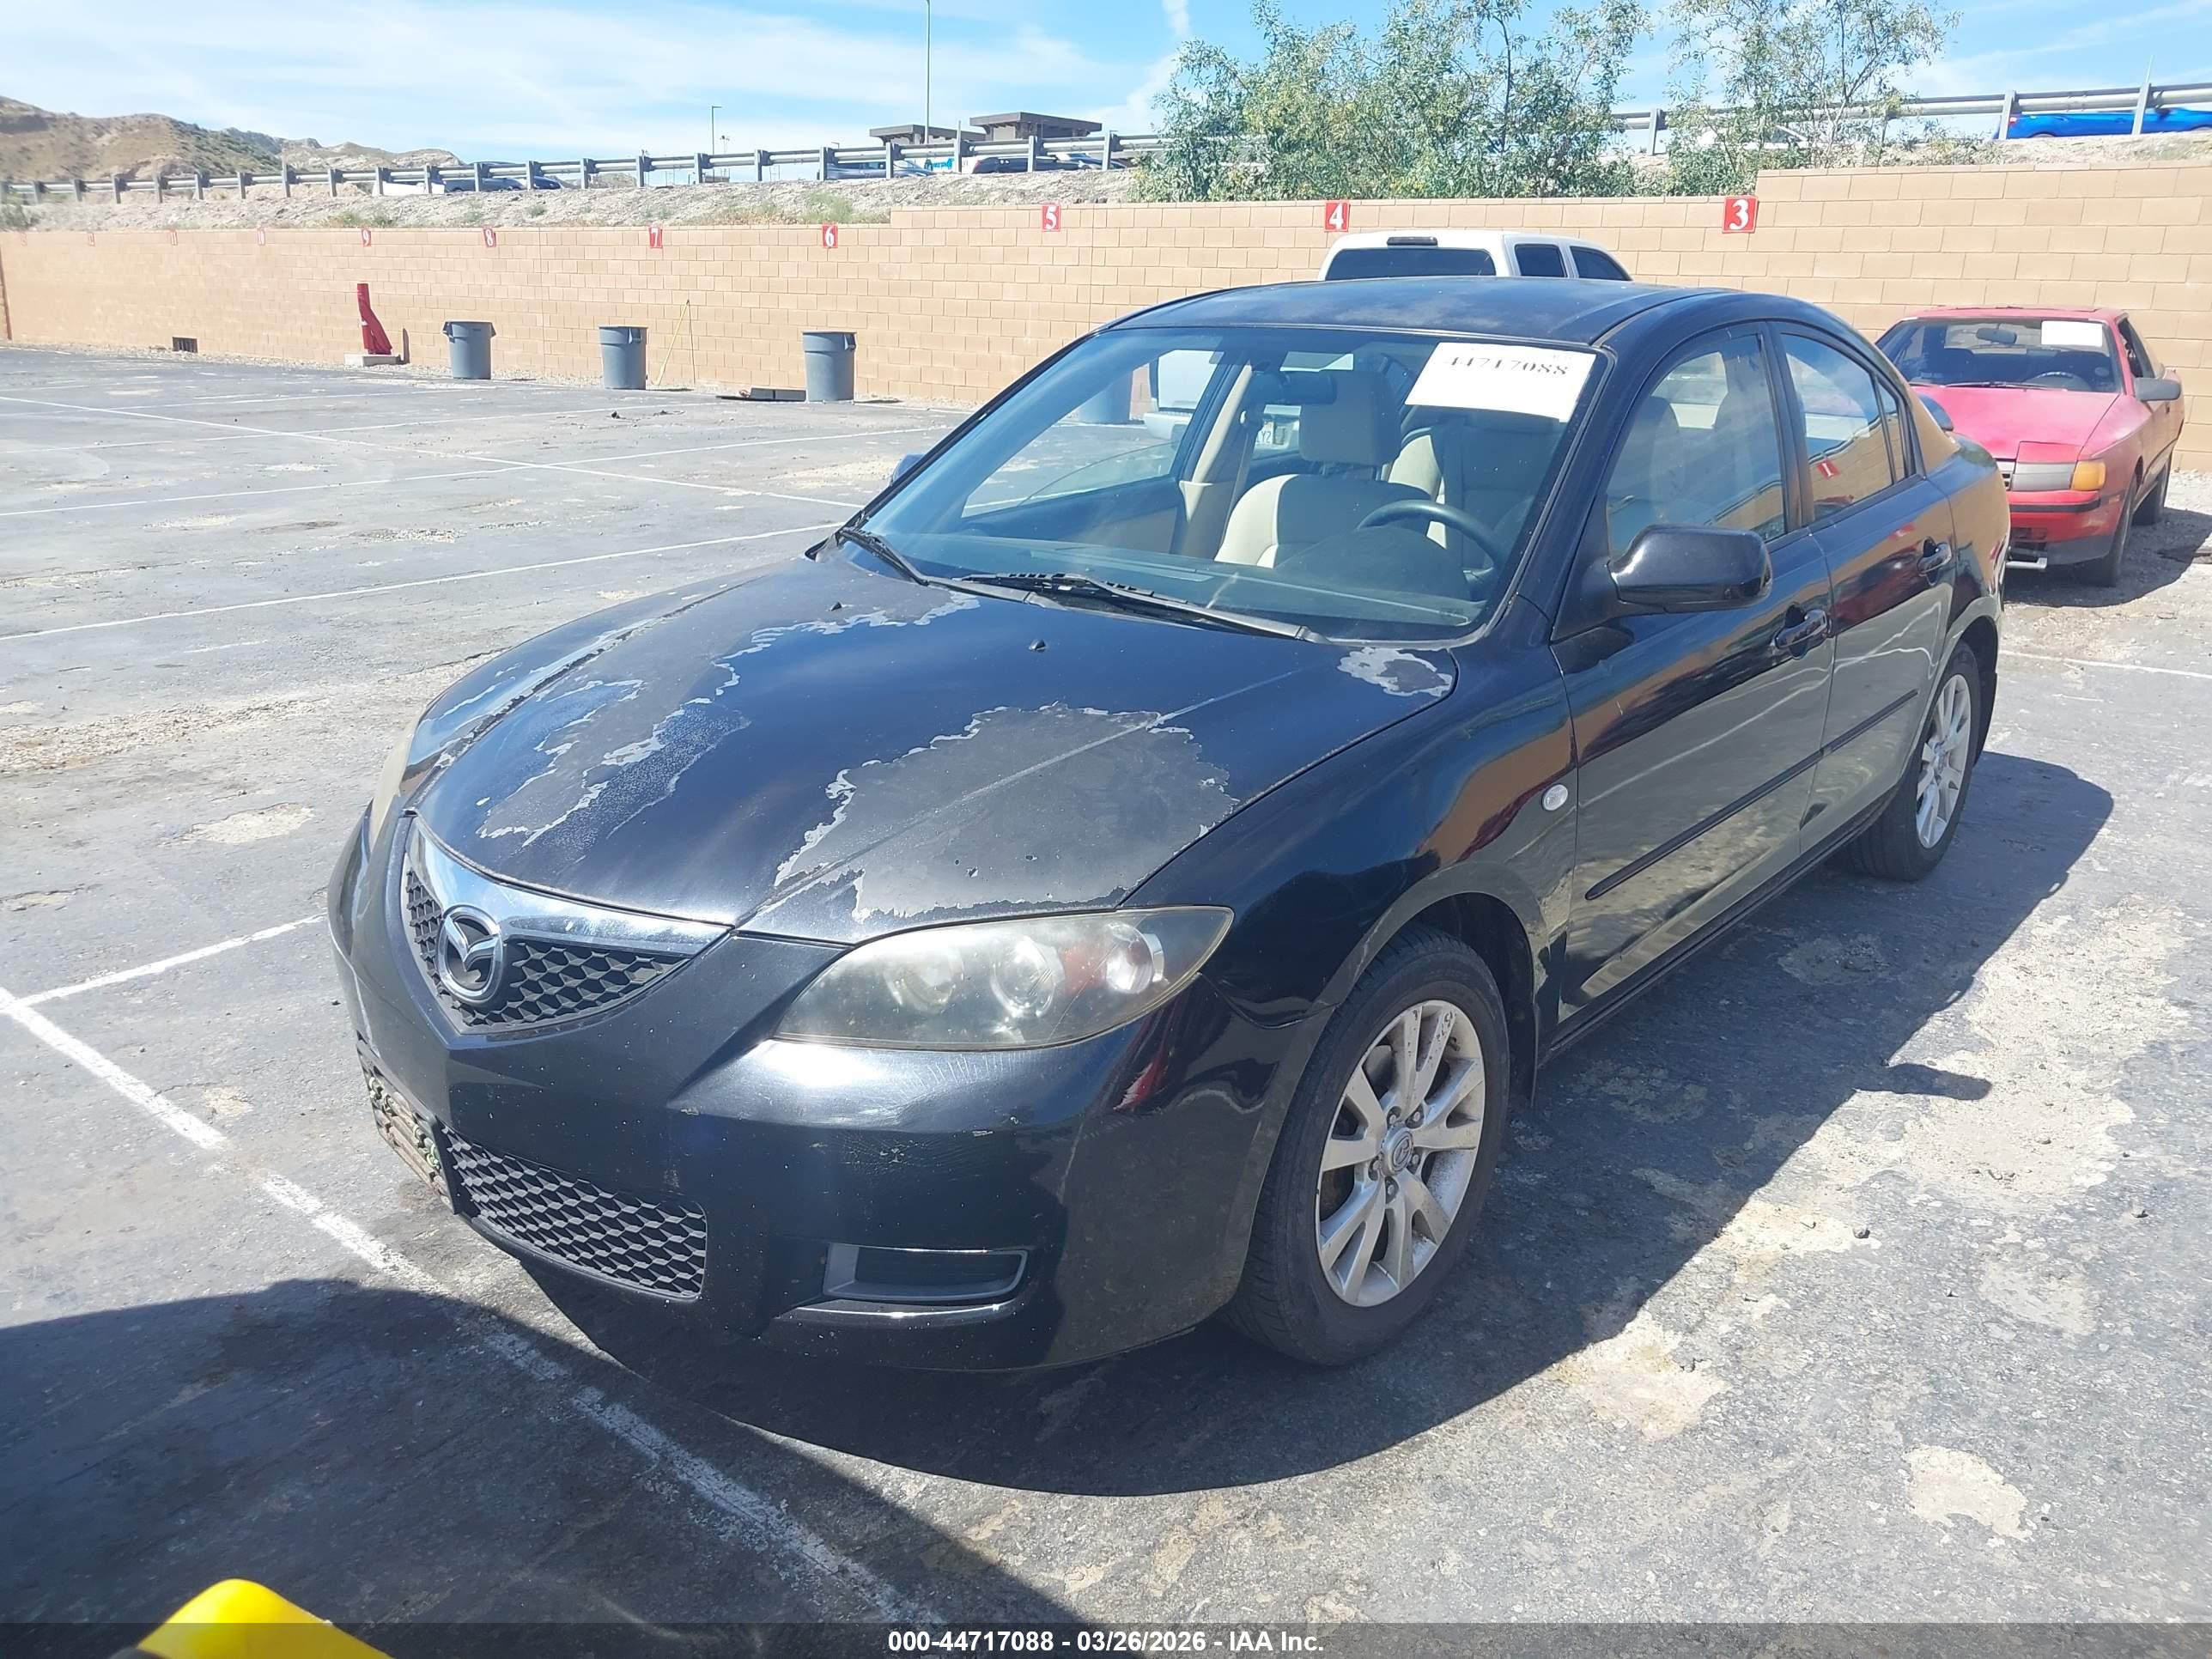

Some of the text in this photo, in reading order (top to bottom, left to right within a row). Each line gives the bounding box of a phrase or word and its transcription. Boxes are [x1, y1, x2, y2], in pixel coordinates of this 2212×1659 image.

[1045, 205, 1057, 229] 5
[1328, 203, 1345, 229] 4
[1729, 198, 1749, 230] 3
[362, 228, 369, 246] 9
[485, 228, 494, 246] 8
[651, 228, 659, 247] 7
[825, 226, 835, 247] 6
